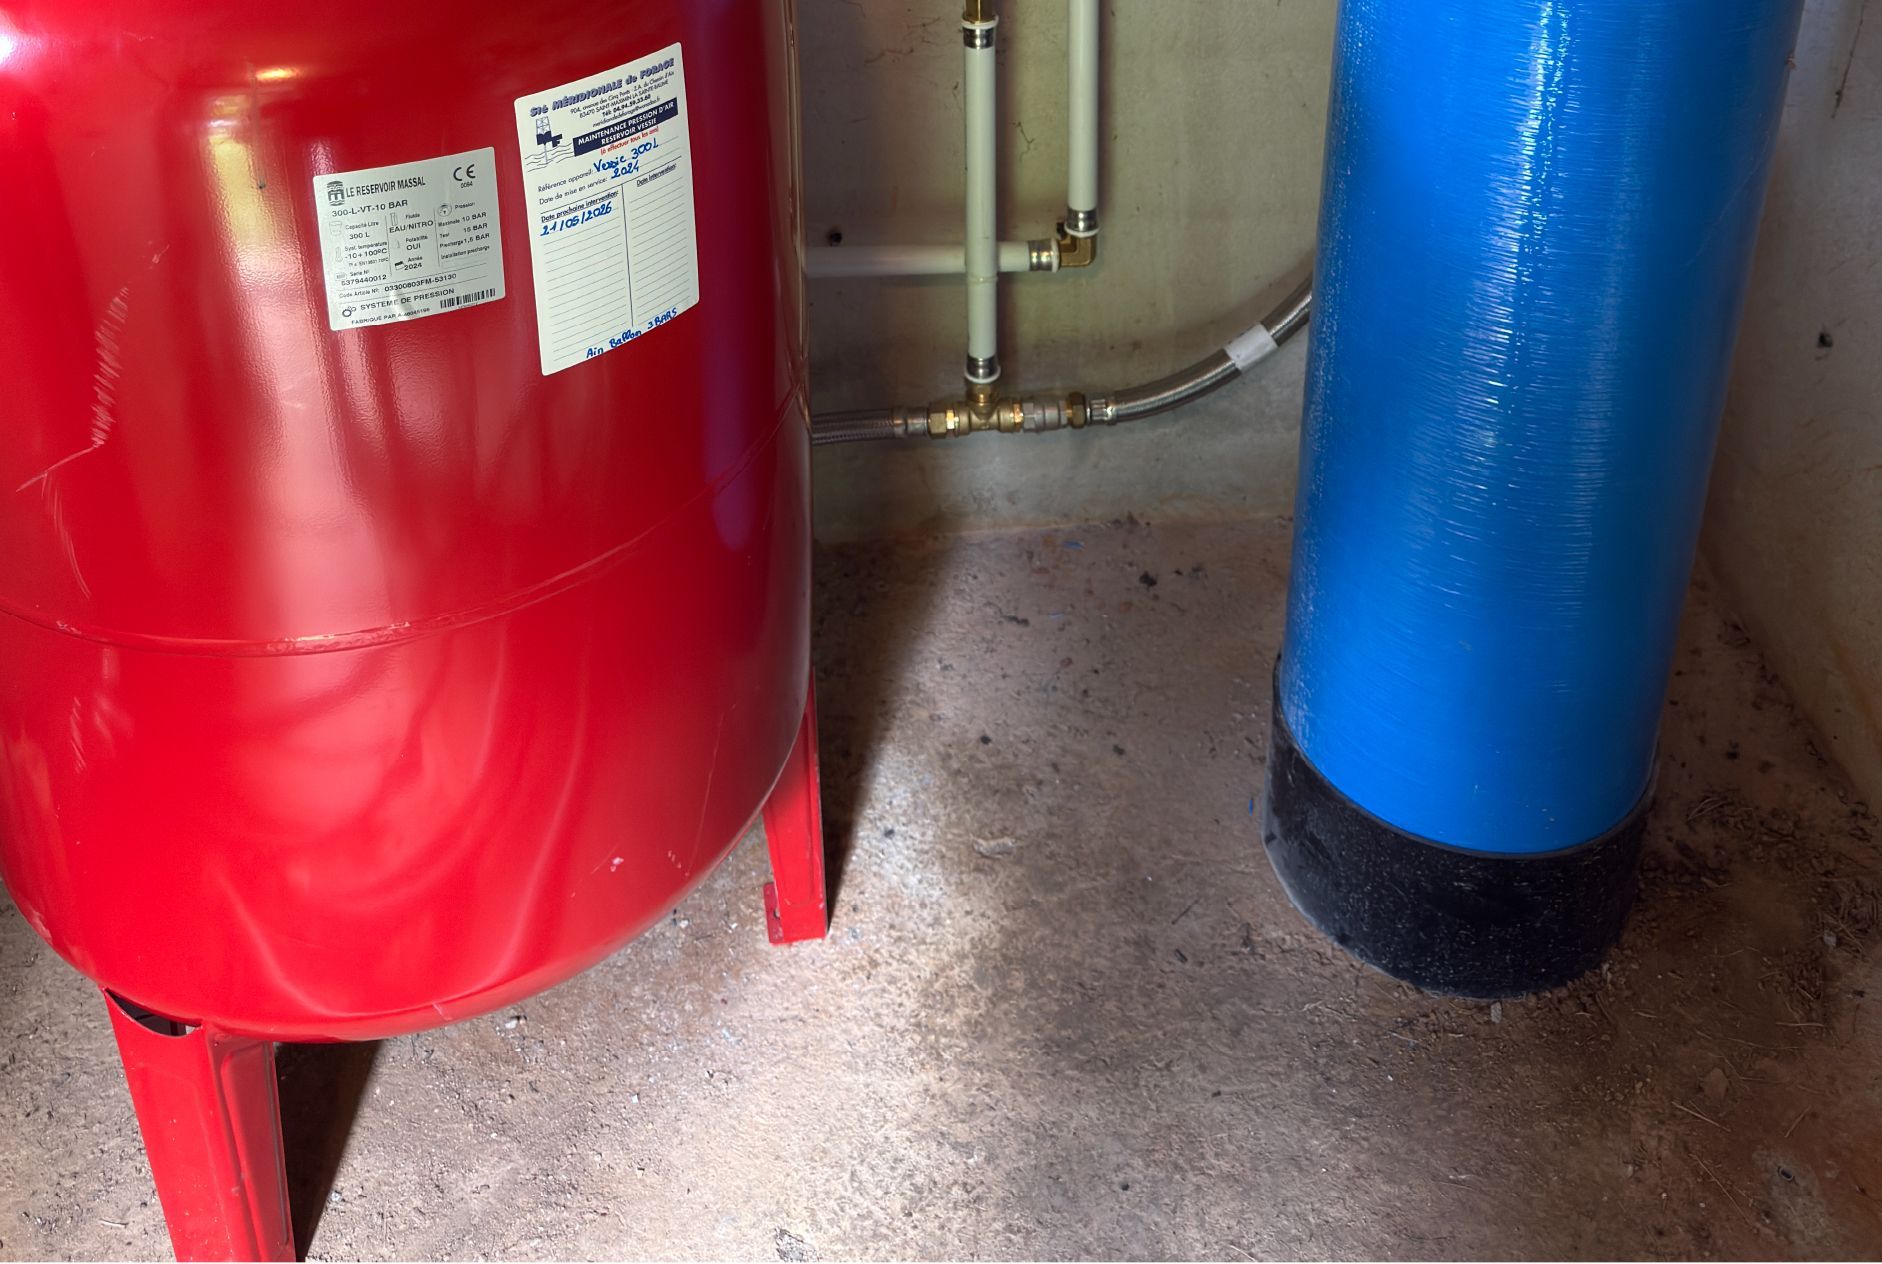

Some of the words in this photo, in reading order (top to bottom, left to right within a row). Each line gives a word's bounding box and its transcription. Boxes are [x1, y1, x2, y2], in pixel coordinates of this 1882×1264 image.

[552, 79, 623, 111] MÉRIDIONALE
[625, 74, 638, 85] de
[640, 57, 675, 79] FORAGE
[582, 102, 599, 110] avenue
[600, 97, 608, 105] des
[608, 93, 619, 102] Cinq
[578, 121, 627, 145] MAINTENANCE
[628, 108, 658, 127] PRESSION
[658, 101, 674, 113] D'AIR
[601, 126, 636, 145] RESERVOIR
[637, 117, 657, 130] VESSIE
[607, 139, 630, 152] effectuer
[630, 135, 641, 143] tous
[641, 131, 649, 139] les
[453, 163, 476, 181] CE
[593, 155, 627, 173] Vessie
[611, 160, 641, 179] 2024
[346, 186, 355, 198] LE
[356, 180, 396, 196] RESERVOIR
[397, 176, 426, 189] MASSAL
[537, 179, 567, 193] Référence
[636, 177, 649, 187] Date
[539, 196, 554, 205] Date
[554, 192, 563, 201] de
[564, 187, 577, 197] mise
[332, 203, 386, 217] 300-L-VT-10
[388, 199, 409, 209] BAR
[471, 211, 487, 220] BAR
[541, 213, 556, 223] Date
[556, 203, 585, 219] prochaine
[389, 220, 434, 234] EAU/NITRO
[472, 222, 488, 231] BAR
[540, 201, 613, 237] 21/05/2026
[349, 232, 363, 240] 300
[475, 232, 490, 241] BAR
[406, 243, 421, 251] OUI
[404, 262, 423, 271] 2024
[360, 298, 399, 310] SYSTEME
[400, 296, 412, 305] DE
[414, 288, 455, 302] PRESSION
[351, 314, 383, 325] FABRIQUE
